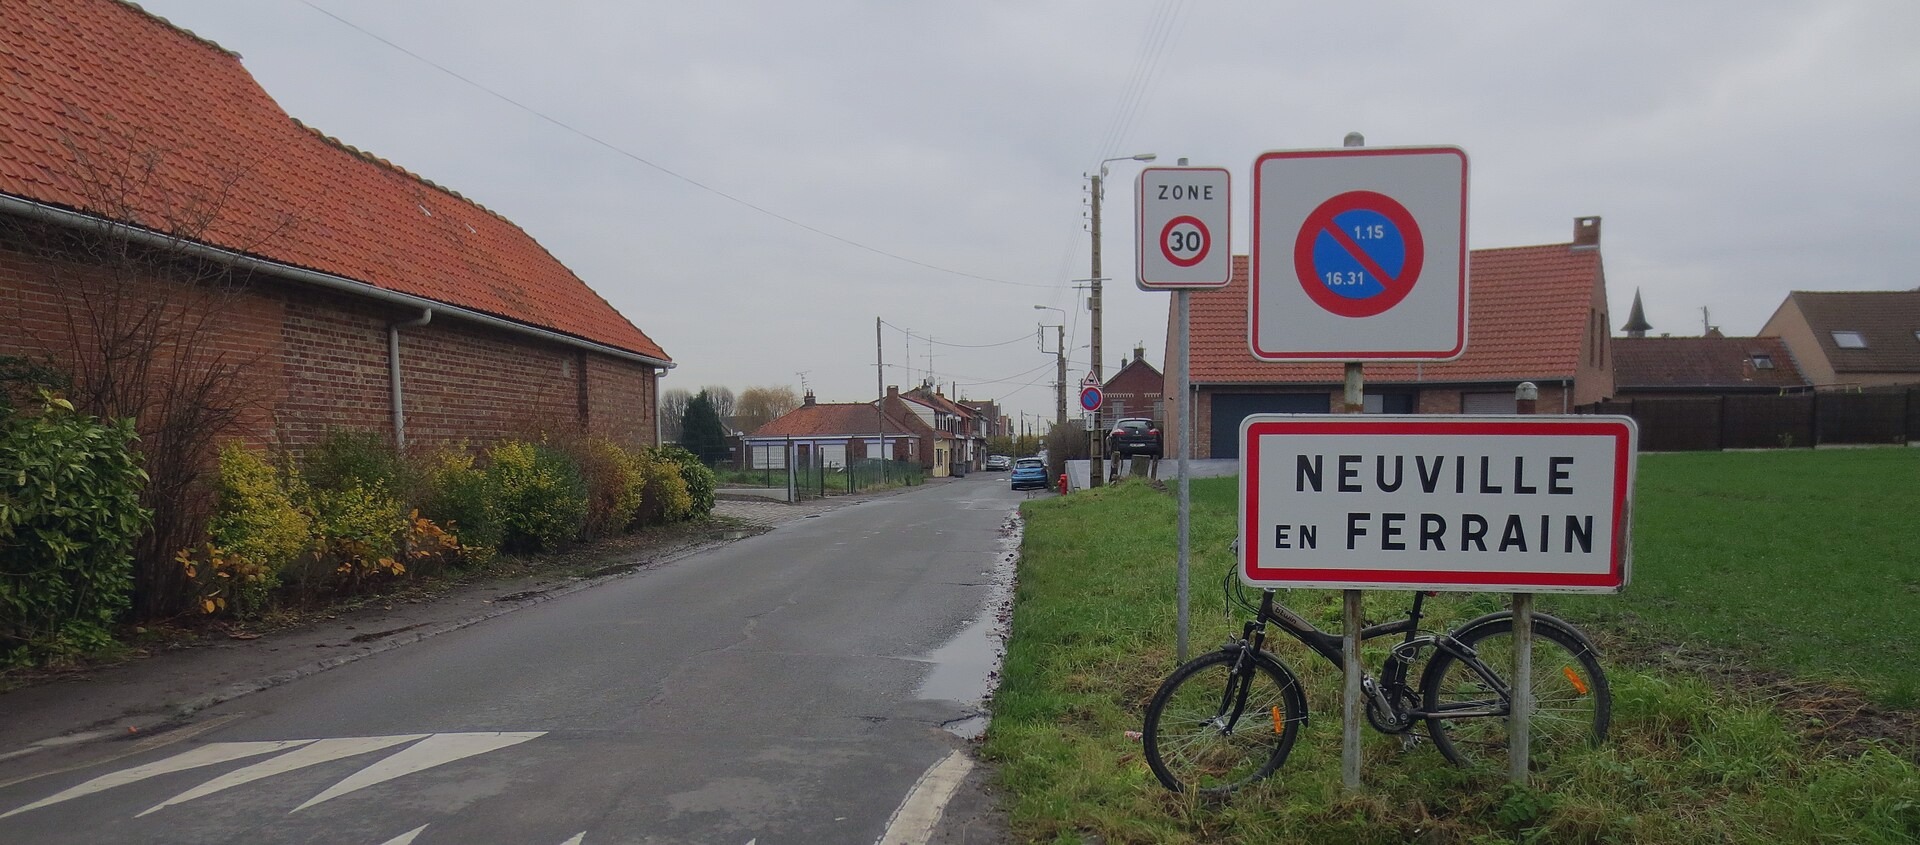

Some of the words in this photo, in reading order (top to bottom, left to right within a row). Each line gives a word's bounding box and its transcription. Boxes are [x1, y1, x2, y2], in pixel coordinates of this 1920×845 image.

[1158, 185, 1213, 200] ZONE
[1170, 231, 1201, 252] 30
[1354, 225, 1384, 240] 1.15
[1326, 271, 1364, 285] 16.31
[1295, 454, 1575, 495] NEUVILLE
[1275, 524, 1317, 549] EN
[1346, 512, 1594, 553] FERRAIN
